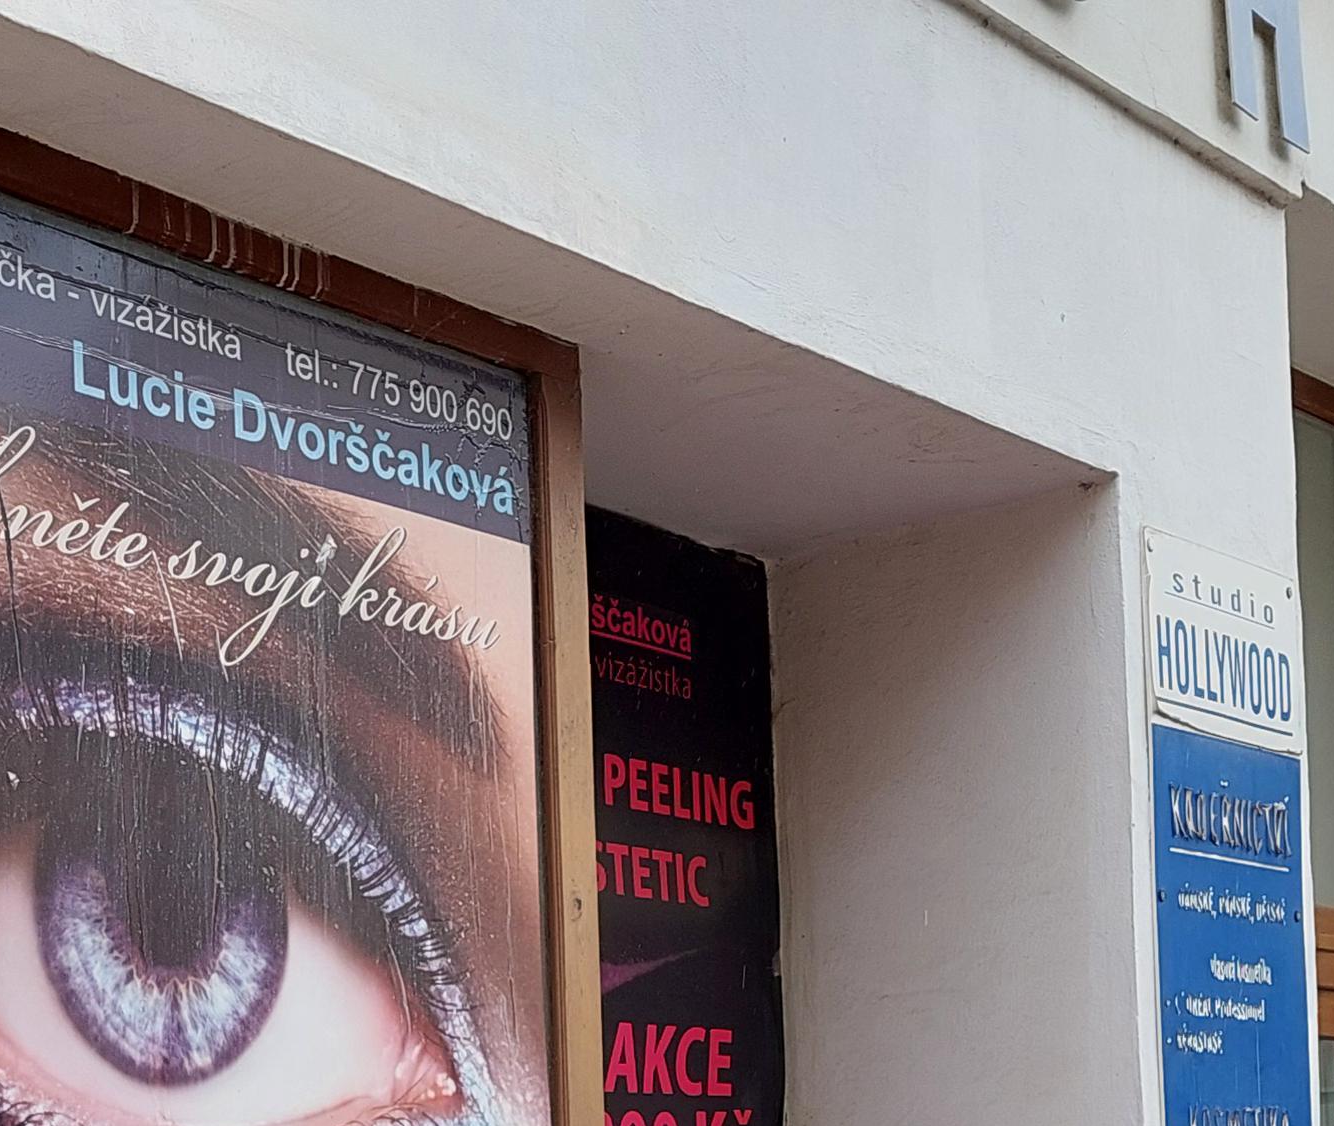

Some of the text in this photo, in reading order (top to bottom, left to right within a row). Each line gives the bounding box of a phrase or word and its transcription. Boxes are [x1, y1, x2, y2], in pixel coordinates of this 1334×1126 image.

[91, 285, 243, 361] vizážistka
[285, 340, 338, 388] tel.:
[348, 361, 402, 406] 775
[409, 378, 458, 425] 900
[465, 393, 513, 442] 690
[72, 340, 517, 516] Lucie Dvorščaková
[166, 543, 329, 666] svoji
[341, 525, 502, 651] krásu
[591, 593, 692, 653] ščaková
[1172, 572, 1274, 624] studio
[594, 651, 692, 700] vizážistka
[1156, 614, 1292, 722] HOLLYWOOD
[603, 753, 756, 830] PEELING
[1169, 780, 1292, 858] KADEŘNICTVÍ
[604, 1021, 734, 1097] AKCE
